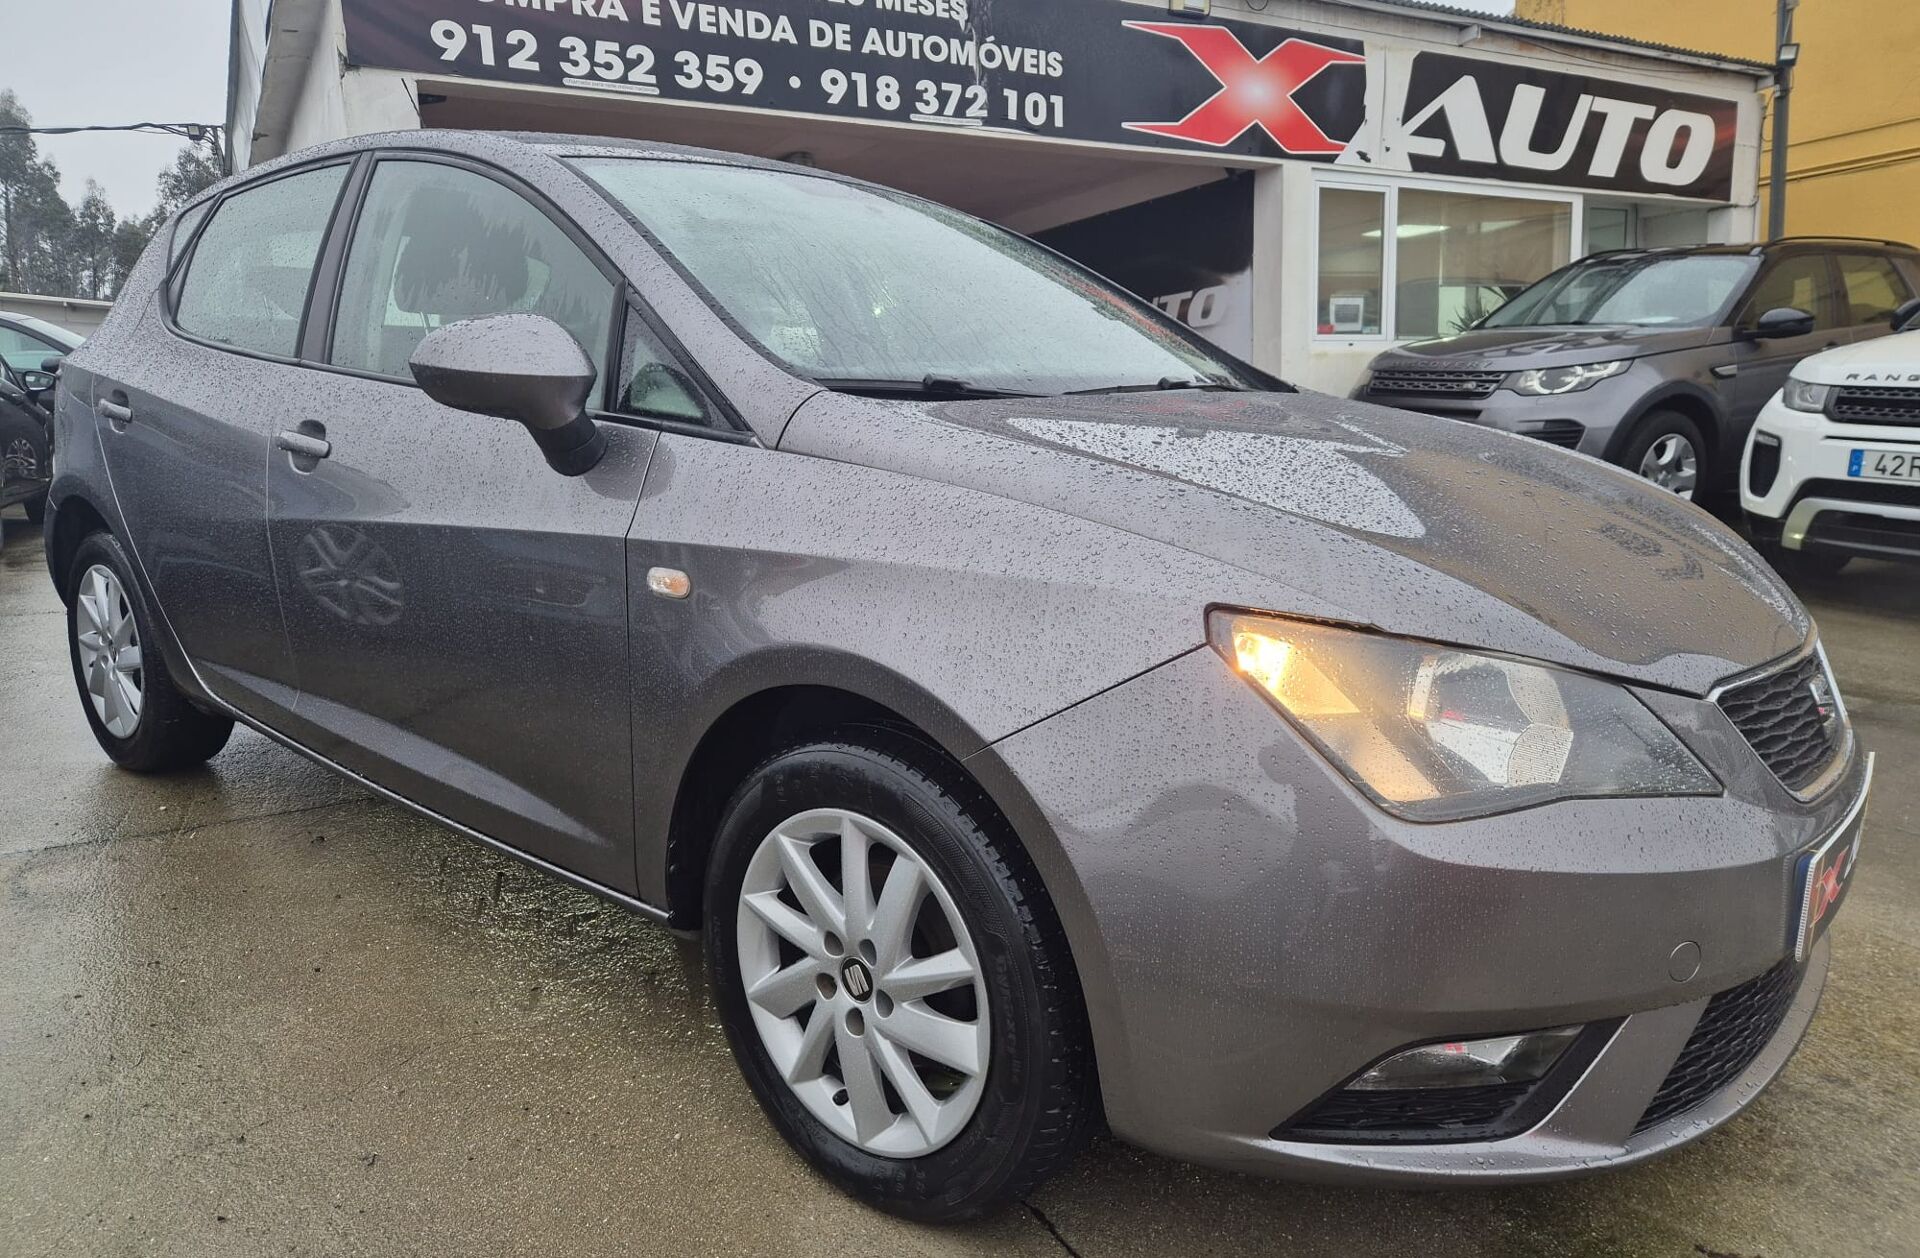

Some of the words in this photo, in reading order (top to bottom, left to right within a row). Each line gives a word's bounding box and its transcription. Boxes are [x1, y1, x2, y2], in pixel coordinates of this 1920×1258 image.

[430, 19, 541, 72] 912
[558, 36, 657, 84] 352
[674, 50, 764, 95] 359
[820, 68, 901, 111] 918
[915, 79, 989, 118] 372
[1003, 88, 1064, 128] 101
[641, 0, 662, 26] E
[670, 0, 798, 45] VENDA
[808, 19, 851, 51] DE
[861, 27, 1064, 78] AUTOMÓVEIS
[1334, 74, 1716, 186] AUTO
